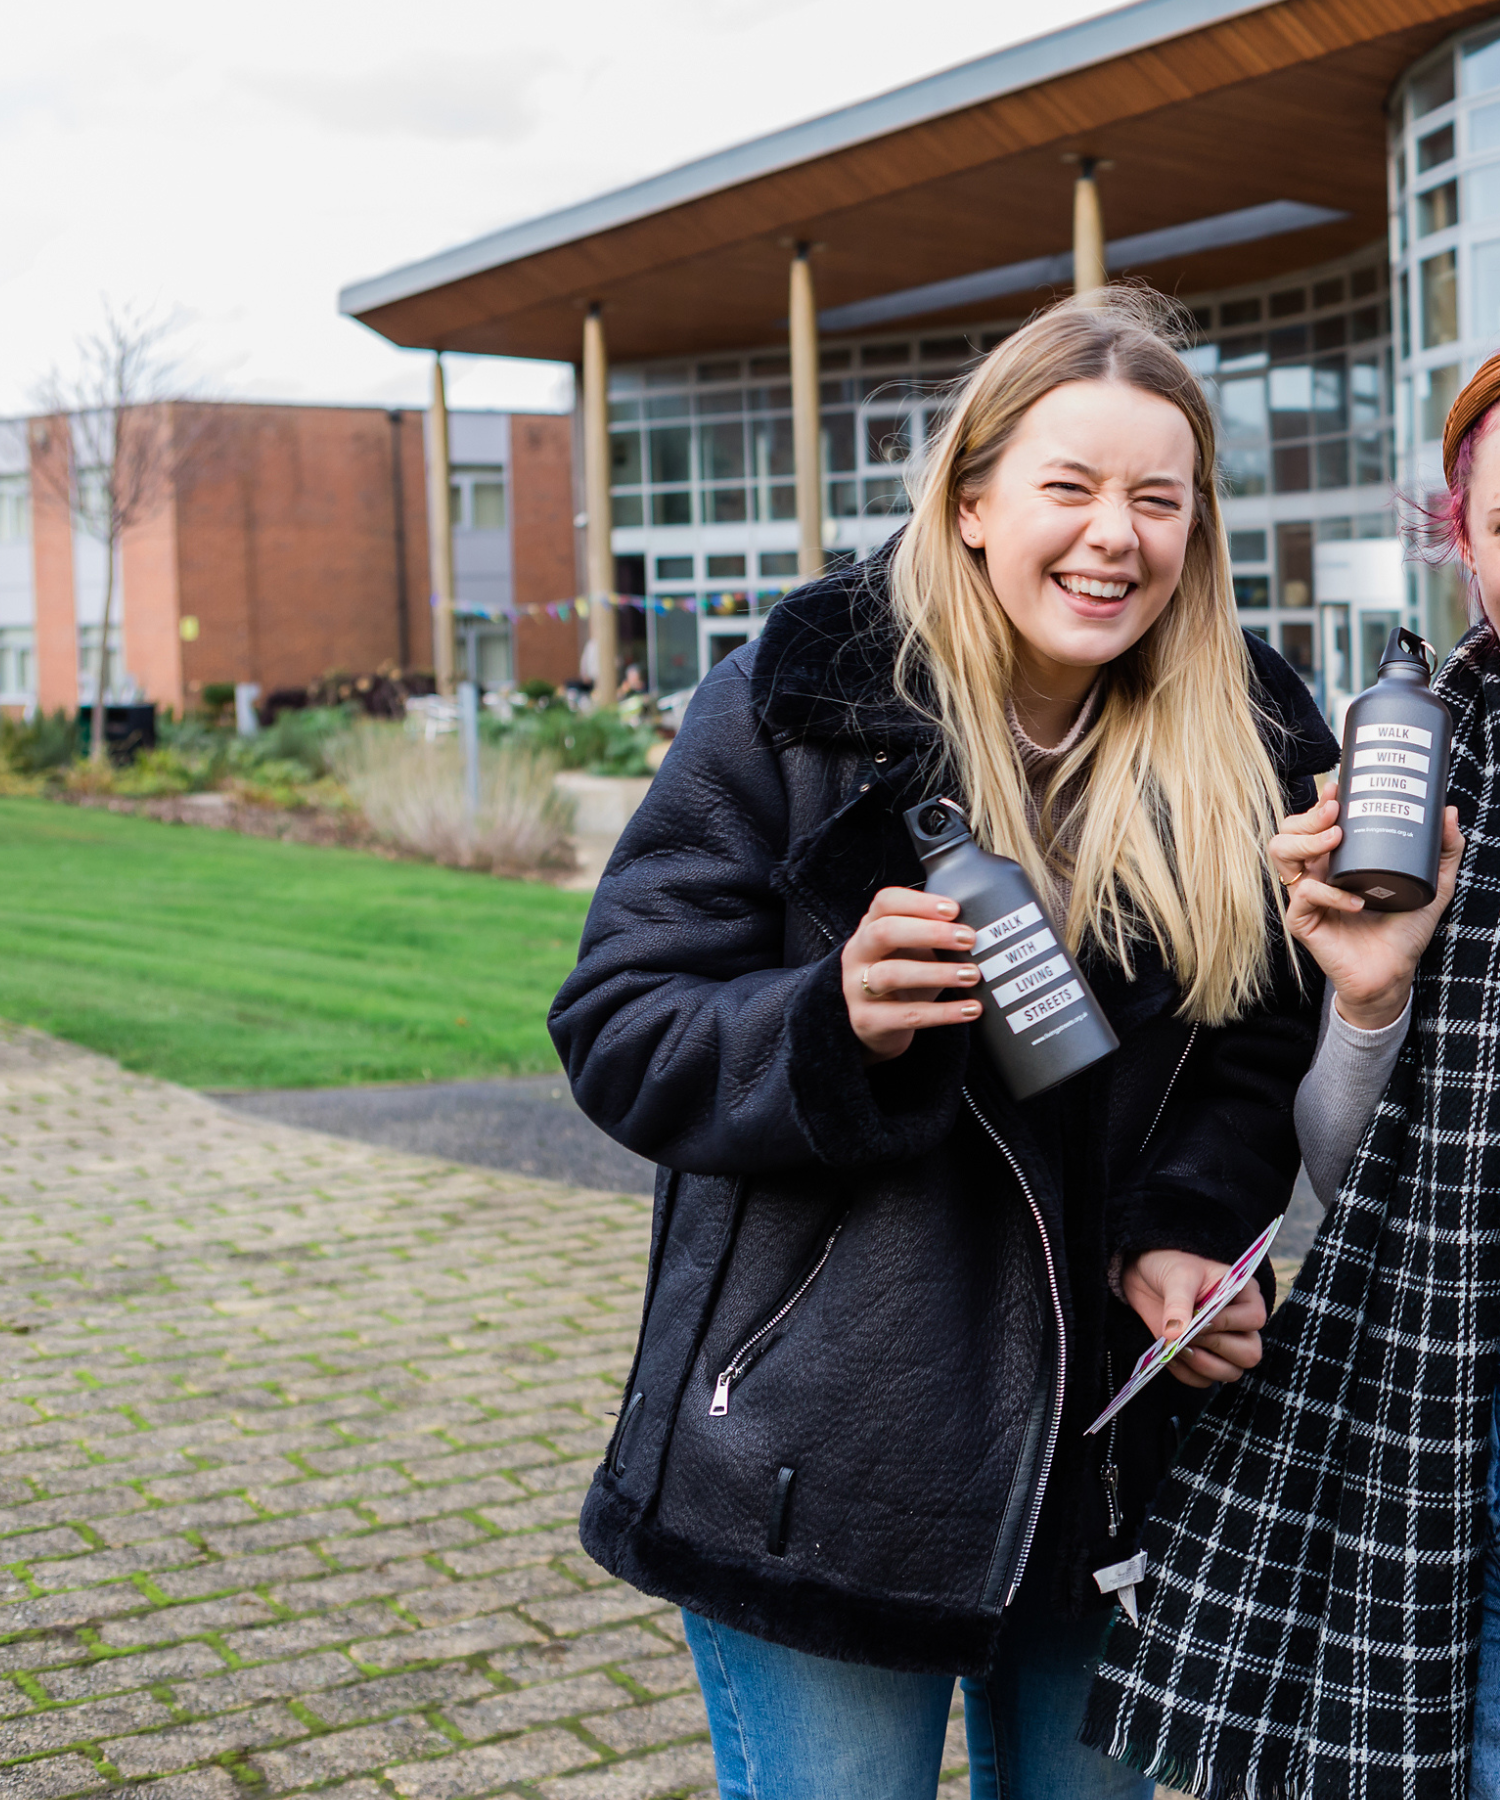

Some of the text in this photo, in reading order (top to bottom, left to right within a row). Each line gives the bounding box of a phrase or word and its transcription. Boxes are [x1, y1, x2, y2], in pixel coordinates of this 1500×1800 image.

[1378, 727, 1410, 739] WALK
[1377, 752, 1406, 764] WITH
[1370, 777, 1407, 789] LIVING
[1361, 802, 1410, 816] STREETS
[989, 914, 1023, 938] WALK
[1004, 941, 1037, 964] WITH
[1015, 965, 1054, 992] LIVING
[1024, 988, 1072, 1022] STREETS
